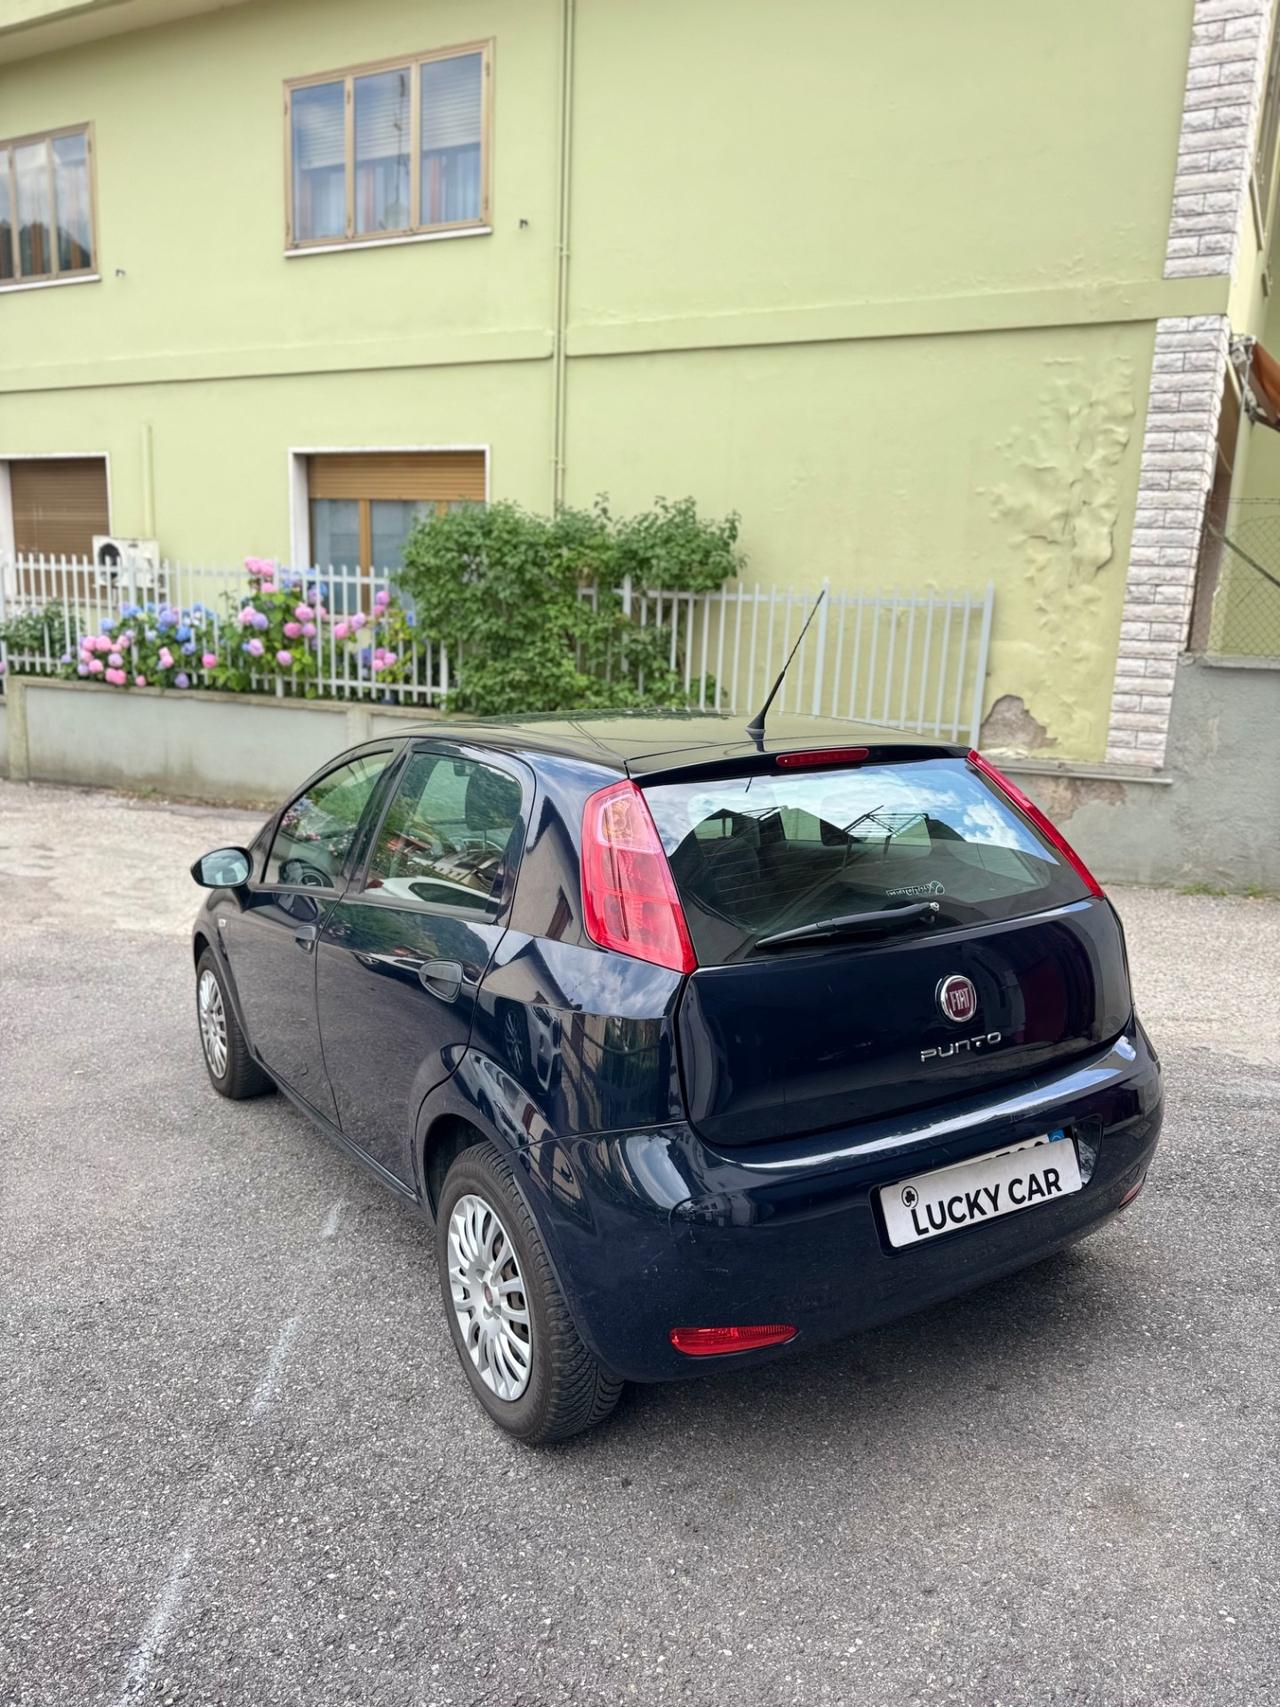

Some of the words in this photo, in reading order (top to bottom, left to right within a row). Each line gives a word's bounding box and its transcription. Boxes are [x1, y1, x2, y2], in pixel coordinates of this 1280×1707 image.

[949, 987, 970, 1012] FIAT
[920, 1031, 1002, 1062] PUNTO
[910, 1184, 1001, 1236] LUCKY
[1007, 1167, 1063, 1205] CAR
